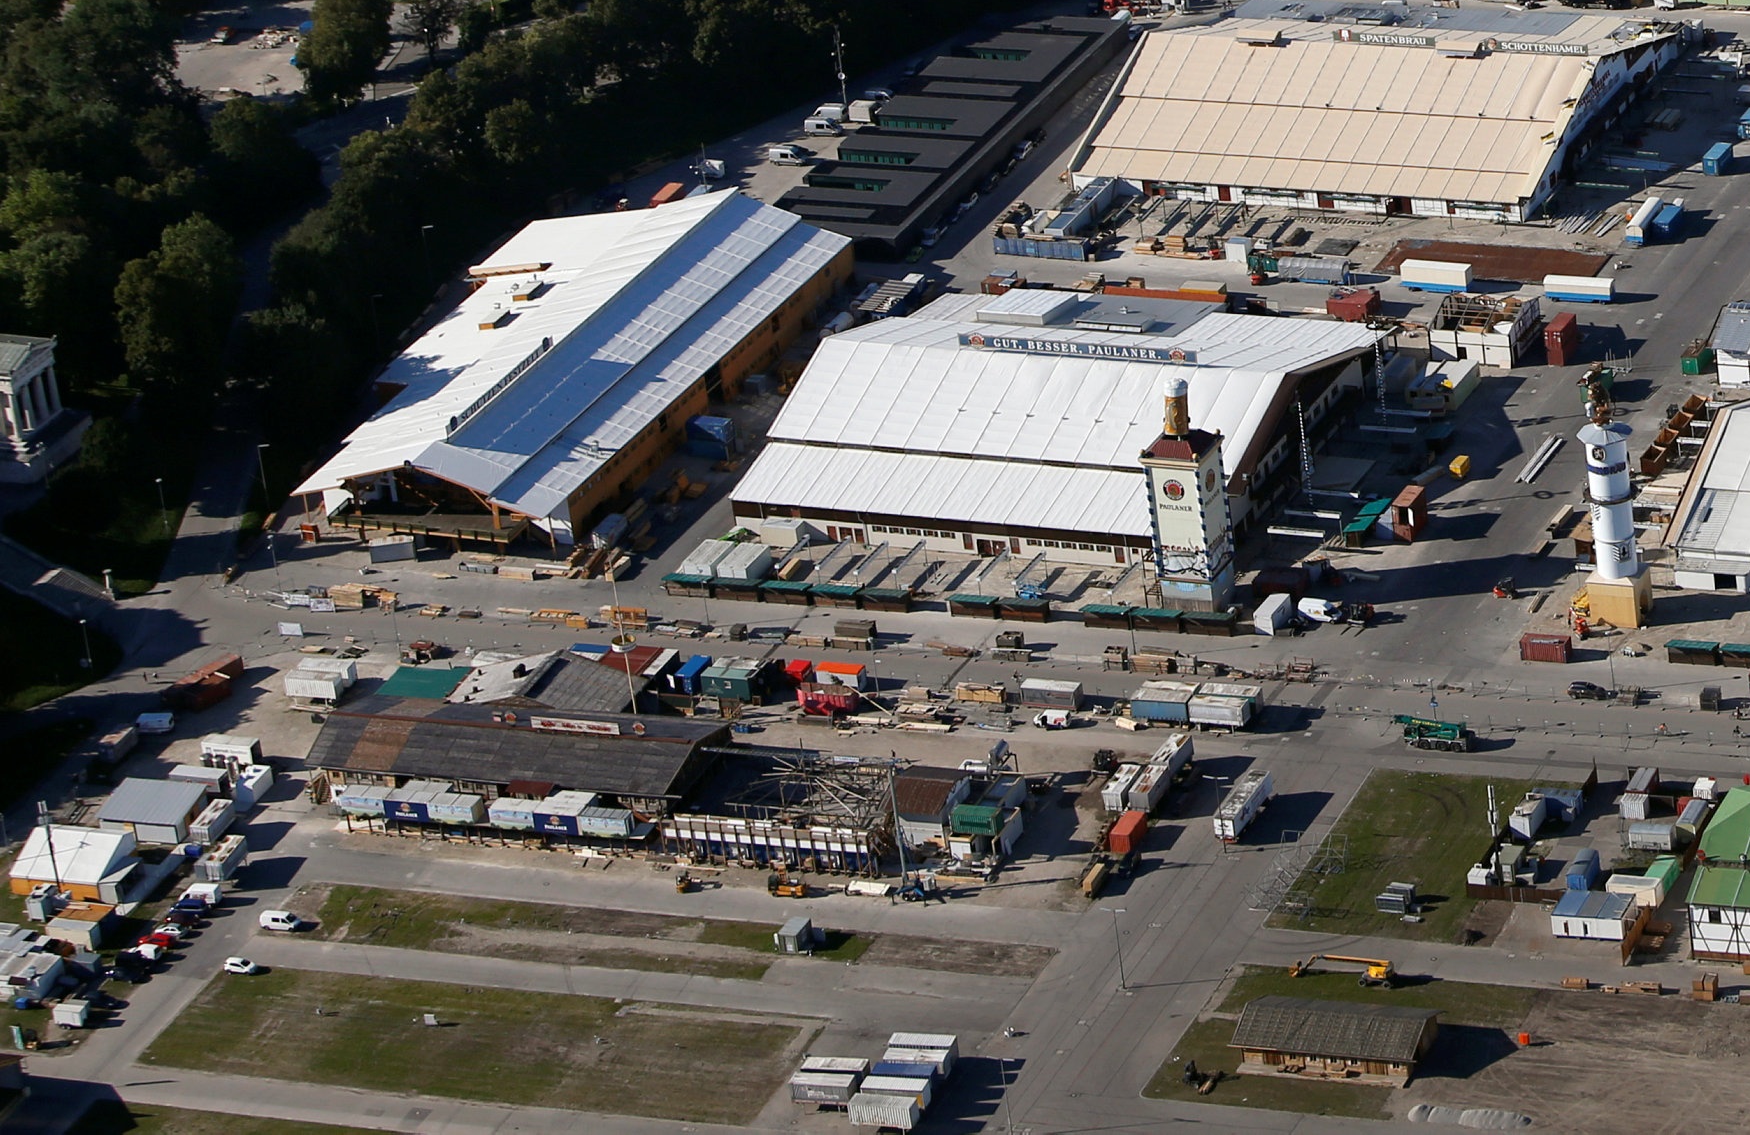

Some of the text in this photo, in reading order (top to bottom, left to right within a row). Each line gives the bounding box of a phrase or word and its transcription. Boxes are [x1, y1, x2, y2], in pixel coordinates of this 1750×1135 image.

[1501, 41, 1586, 54] SCHOTTENHAMEL
[993, 338, 1162, 360] GUT, BESSER, PAULANER.
[1160, 503, 1193, 512] PAULANER
